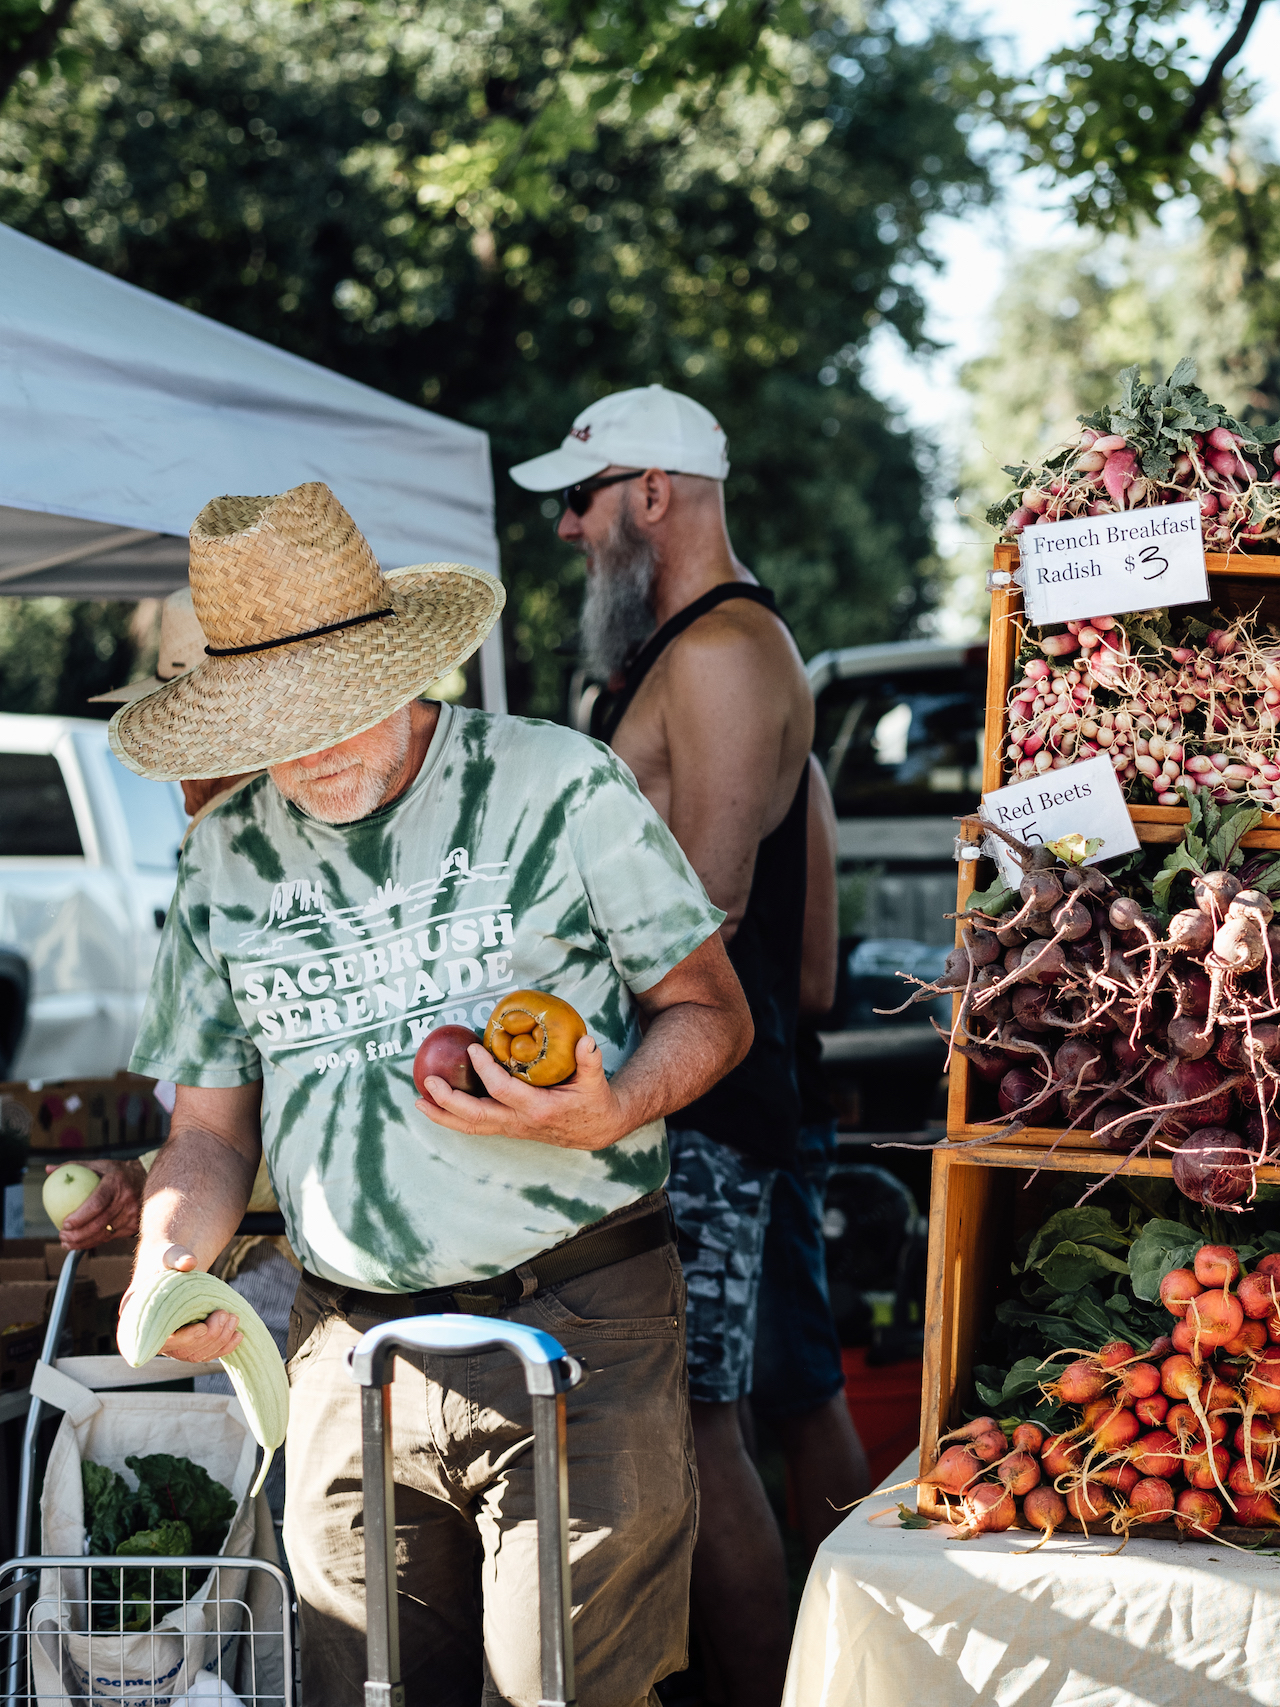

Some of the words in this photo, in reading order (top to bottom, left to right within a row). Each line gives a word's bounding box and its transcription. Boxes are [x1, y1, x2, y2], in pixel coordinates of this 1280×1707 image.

[1033, 526, 1100, 554] French
[1106, 514, 1197, 545] Breakfast
[1036, 559, 1103, 585] Radish
[995, 796, 1035, 825] Red
[1037, 782, 1092, 812] Beets
[244, 912, 516, 1006] SAGEBRUSH
[256, 949, 515, 1042] SERENADE
[313, 1047, 359, 1075] 90.9
[365, 1039, 403, 1063] fm
[407, 1000, 499, 1049] KRC
